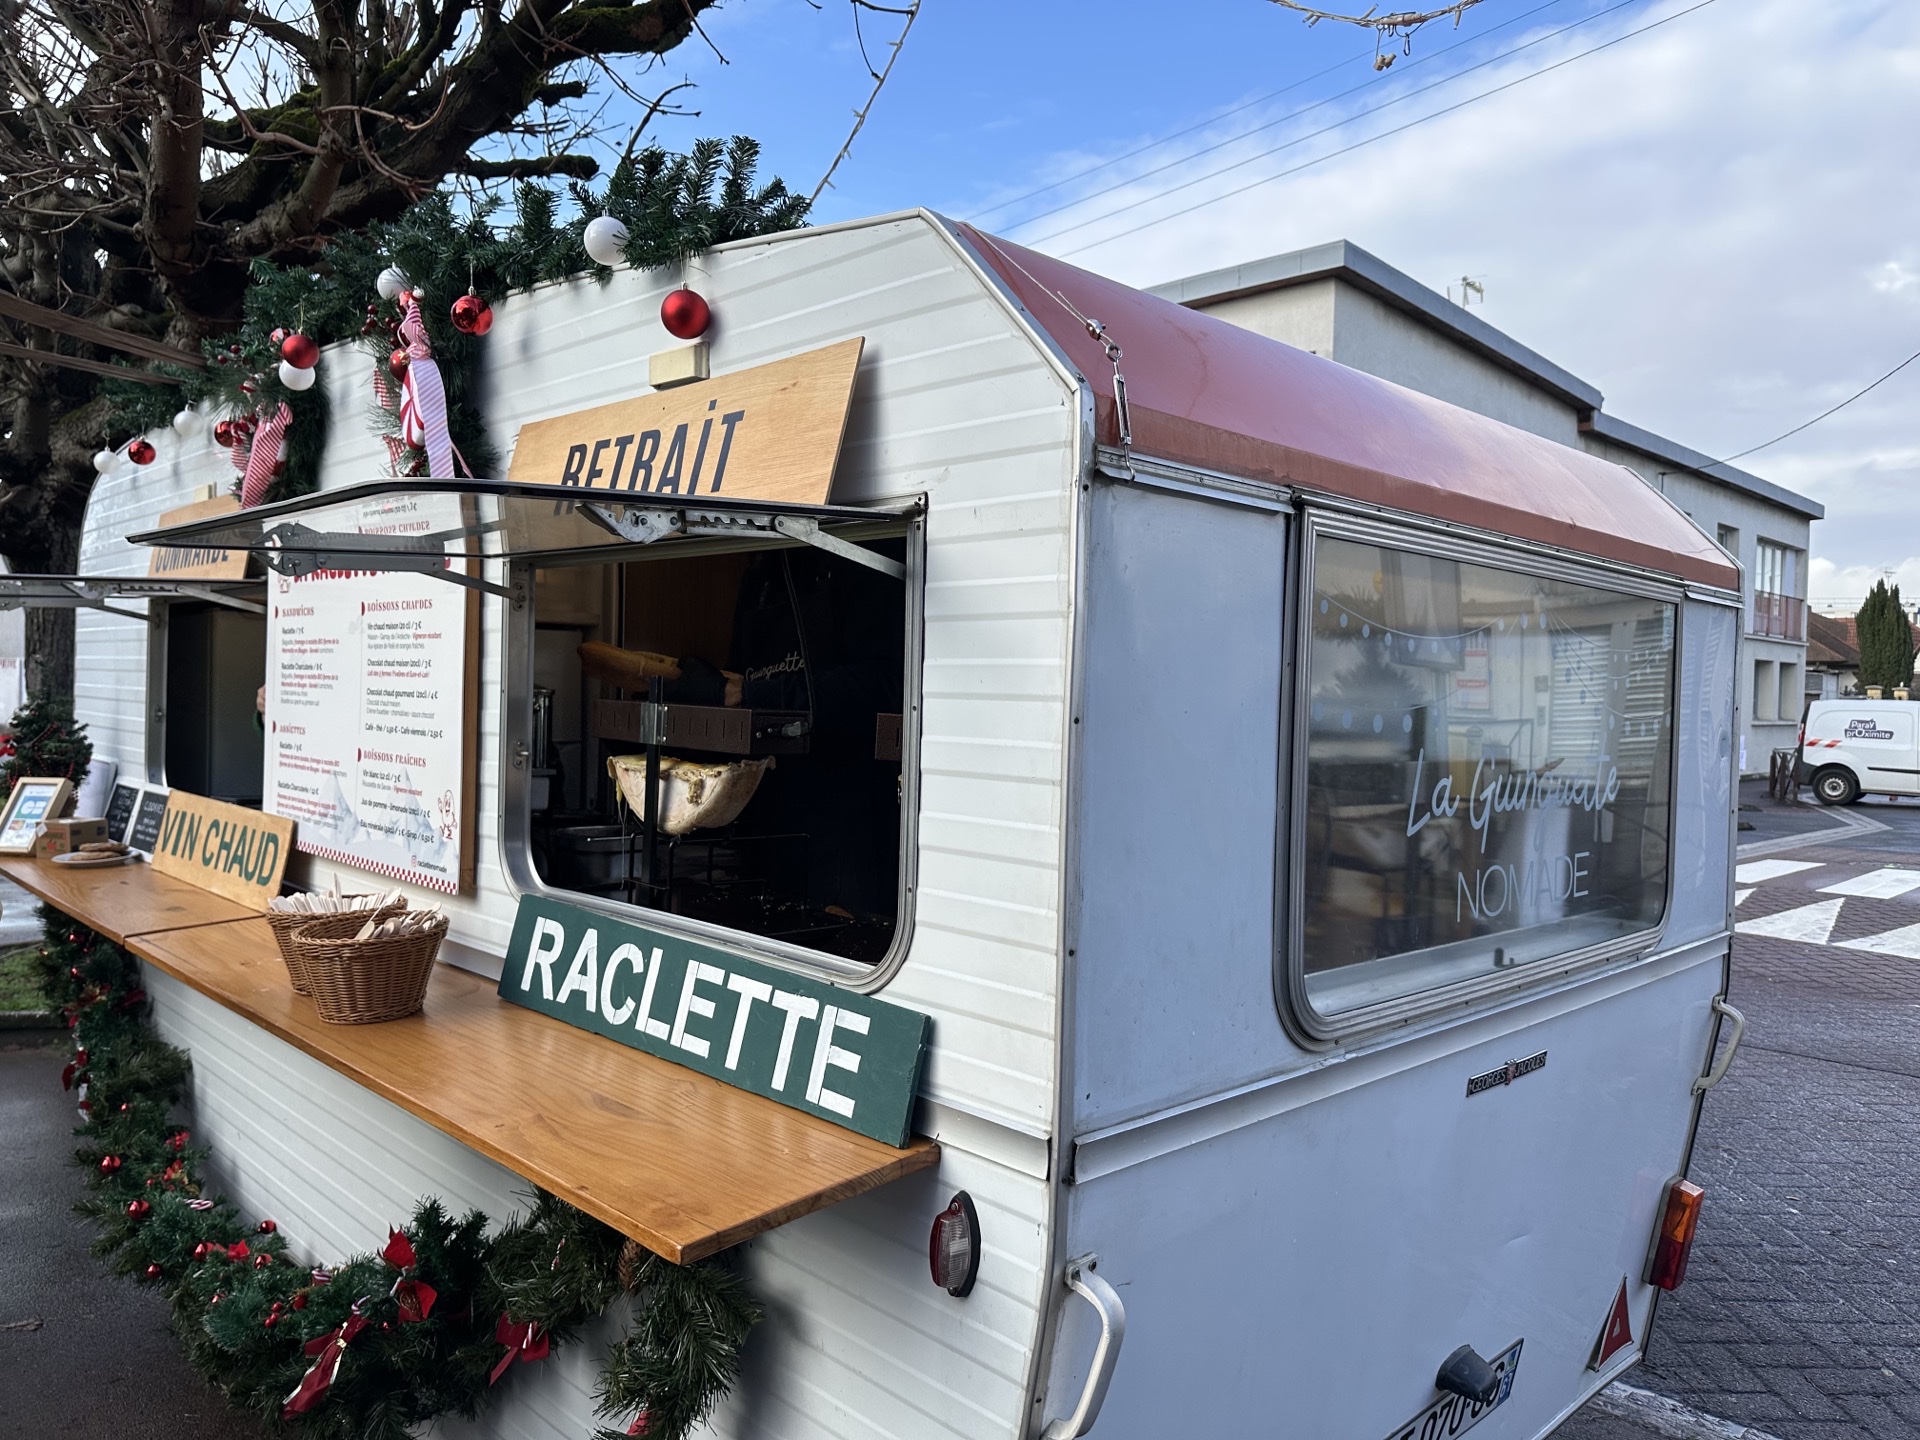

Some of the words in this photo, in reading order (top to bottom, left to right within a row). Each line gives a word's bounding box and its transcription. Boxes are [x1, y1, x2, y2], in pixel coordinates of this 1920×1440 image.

[1406, 747, 1462, 838] La
[160, 807, 203, 861] VIN
[202, 818, 280, 887] CHAUD
[1455, 850, 1590, 924] NOMADE
[520, 915, 872, 1119] RACLETTE
[1471, 1068, 1507, 1093] GEORGES
